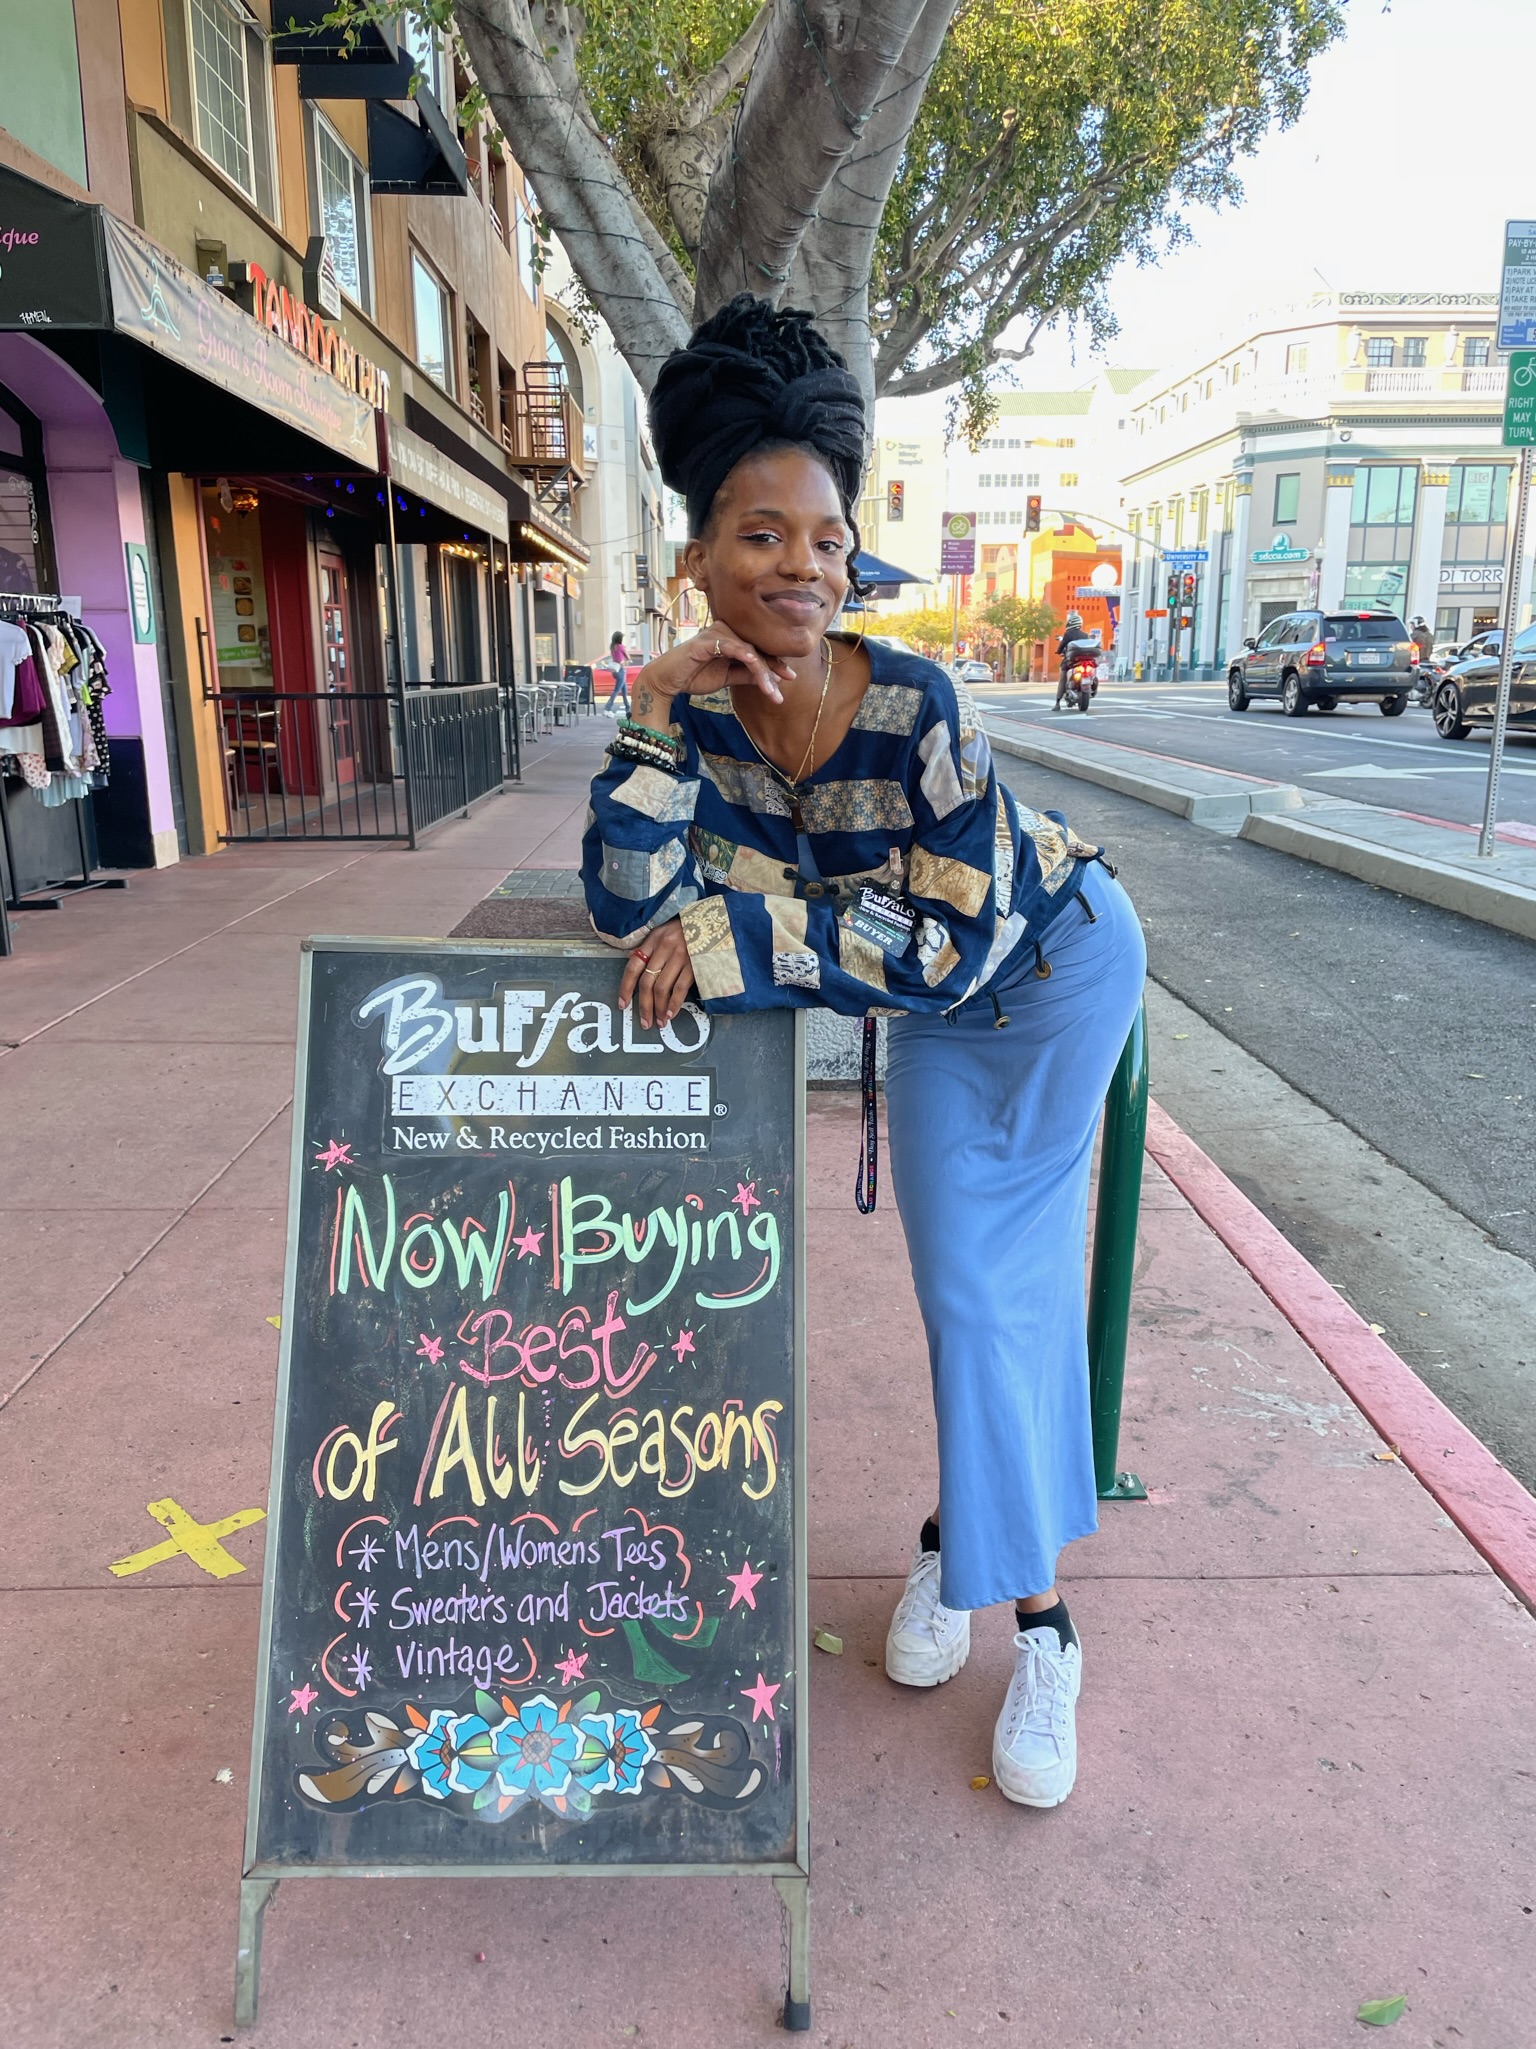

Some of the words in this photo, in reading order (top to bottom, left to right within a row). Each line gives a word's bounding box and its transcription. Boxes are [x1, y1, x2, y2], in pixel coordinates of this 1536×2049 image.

[1508, 397, 1535, 409] RIGHT
[1513, 412, 1532, 424] MAY
[1508, 427, 1533, 438] TURN
[1468, 472, 1489, 484] BIG
[1258, 551, 1302, 561] sdccu.com
[854, 919, 894, 946] BUYER
[399, 1080, 703, 1111] EXCHANGE
[392, 1125, 449, 1151] New
[456, 1125, 484, 1150] &
[490, 1125, 603, 1154] Recycled
[609, 1125, 707, 1150] Fashion
[338, 1174, 509, 1301] Now
[559, 1175, 782, 1316] Buying
[459, 1290, 649, 1389] Best
[326, 1400, 398, 1502] of
[559, 1392, 783, 1501] Seasons
[395, 1523, 601, 1583] Mens/Womens
[601, 1526, 667, 1572] Tees
[389, 1584, 507, 1630] Sweaters
[517, 1582, 570, 1623] and
[587, 1581, 690, 1623] Jackets
[396, 1637, 520, 1690] Vintage
